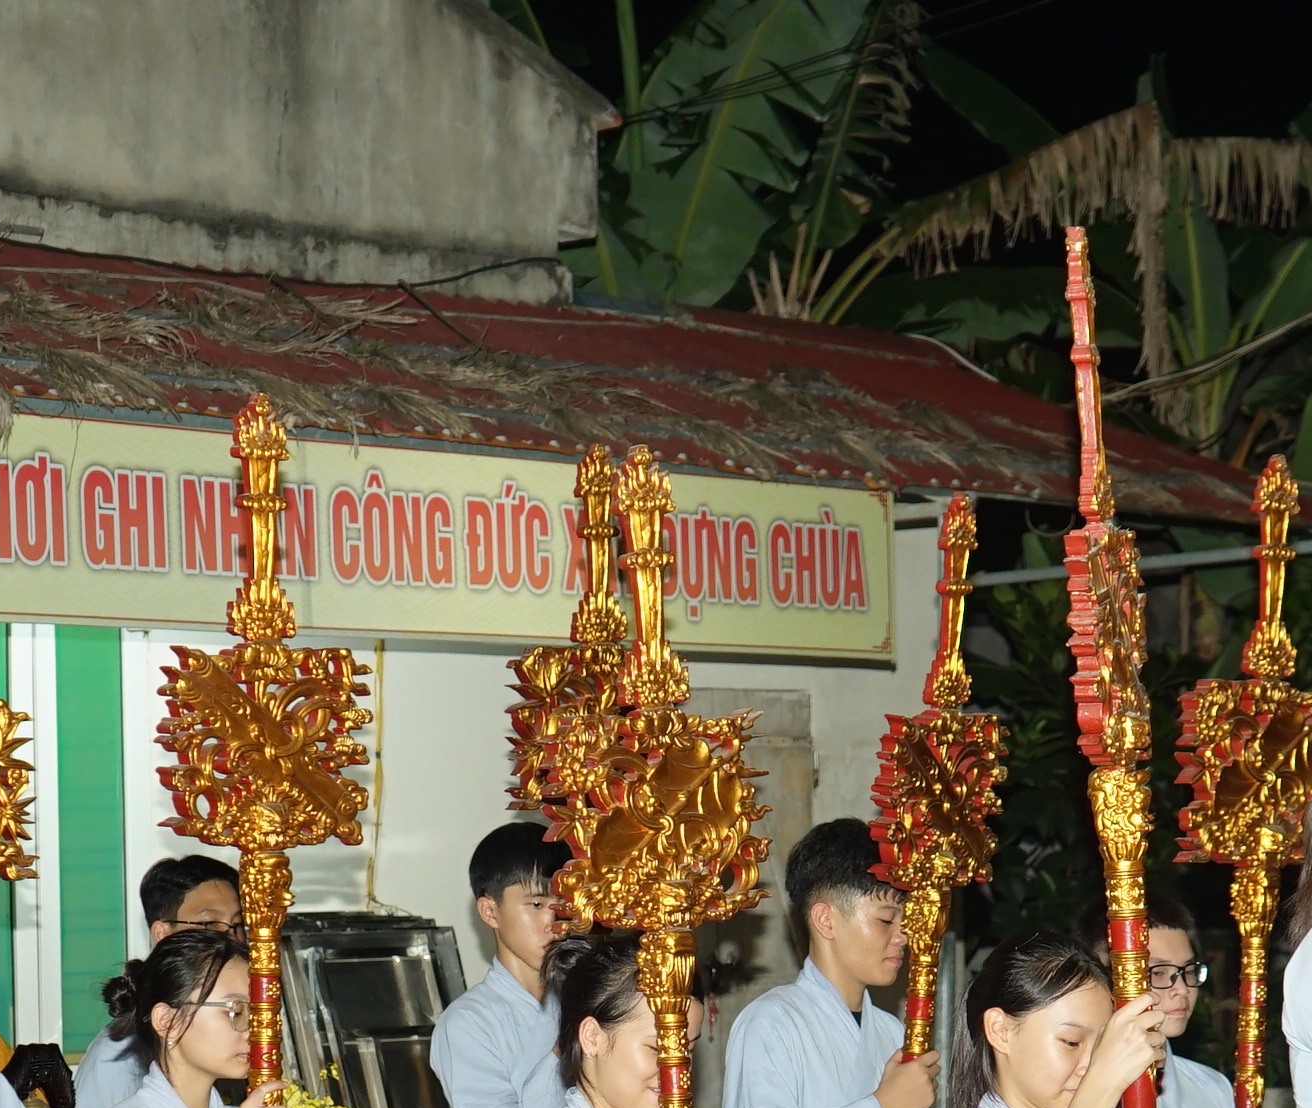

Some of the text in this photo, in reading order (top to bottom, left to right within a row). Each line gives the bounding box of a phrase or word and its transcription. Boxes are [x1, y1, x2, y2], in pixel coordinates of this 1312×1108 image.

[82, 466, 167, 571] GHI
[181, 475, 318, 579] NHN
[331, 471, 455, 587] CÔNG
[465, 481, 550, 592] ĐỨC
[769, 507, 867, 611] CHÙA
